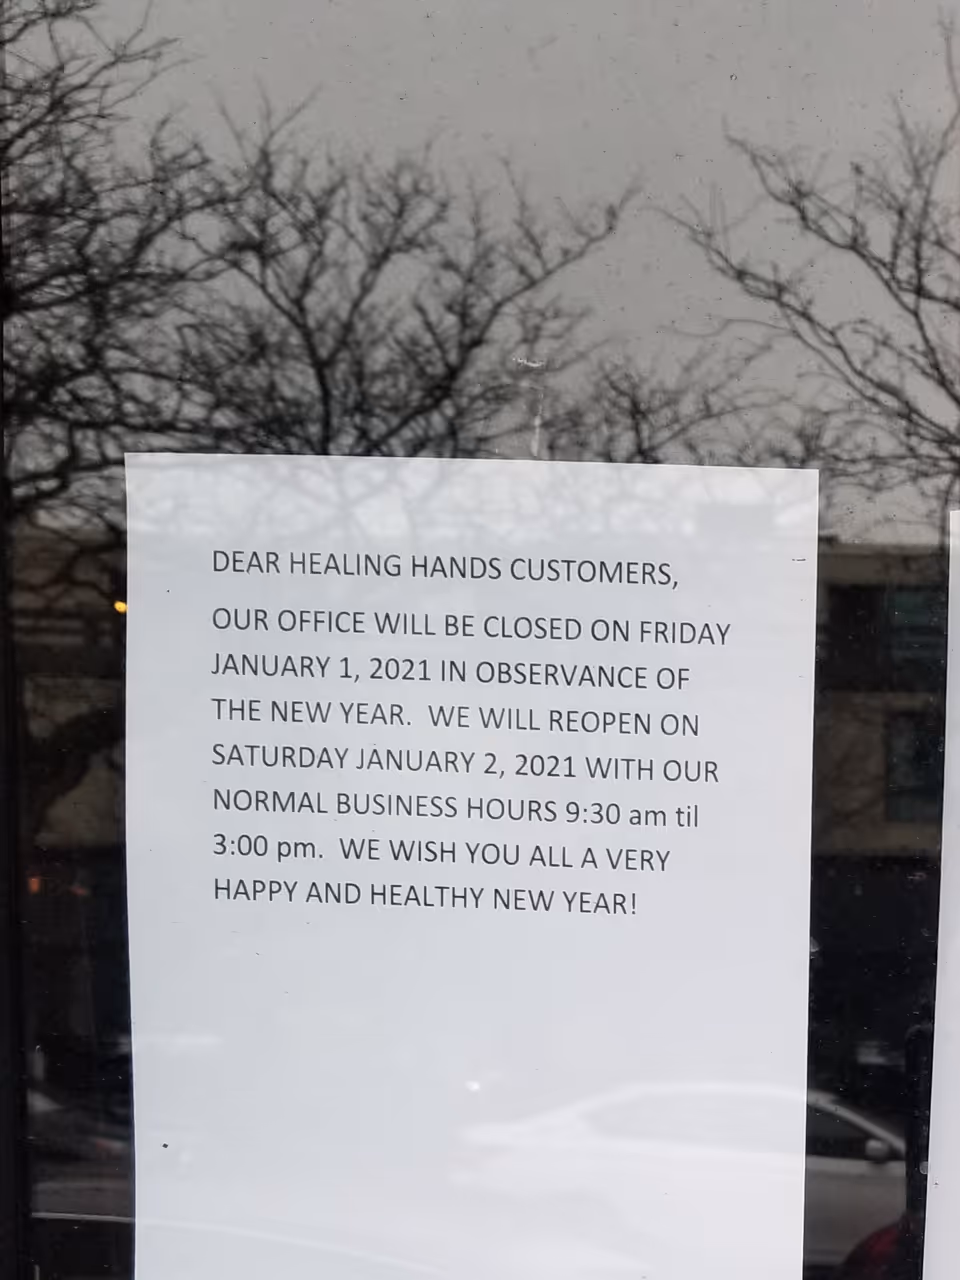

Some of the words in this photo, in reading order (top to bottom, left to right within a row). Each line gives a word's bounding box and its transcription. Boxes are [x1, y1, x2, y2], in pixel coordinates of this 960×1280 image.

[213, 550, 281, 574] DEAR
[290, 552, 401, 577] HEALING
[411, 555, 502, 580] HANDS
[510, 558, 678, 590] CUSTOMERS,
[212, 607, 269, 631] OUR
[277, 609, 365, 634] OFFICE
[374, 611, 436, 636] WILL
[445, 614, 475, 637] BE
[483, 615, 582, 640] CLOSED
[590, 619, 629, 642] ON
[640, 620, 731, 645] FRIDAY
[211, 652, 331, 678] JANUARY
[339, 656, 360, 683] 1,
[369, 657, 431, 681] 2021
[441, 659, 466, 682] IN
[476, 661, 648, 689] OBSERVANCE
[656, 667, 690, 690] OF
[211, 698, 261, 722] THE
[271, 700, 332, 723] NEW
[339, 702, 413, 726] YEAR.
[427, 705, 470, 728] WE
[478, 706, 541, 731] WILL
[549, 709, 651, 735] REOPEN
[660, 713, 699, 737] ON
[212, 743, 349, 769] SATURDAY
[355, 748, 476, 774] JANUARY
[483, 752, 505, 779] 2,
[515, 753, 577, 778] 2021
[585, 756, 653, 781] WITH
[663, 759, 719, 783] OUR
[214, 788, 328, 814] NORMAL
[337, 792, 458, 818] BUSINESS
[467, 797, 557, 822] HOURS
[565, 801, 621, 825] 9:30
[629, 809, 667, 827] am
[675, 804, 698, 828] til
[213, 833, 268, 857] 3:00
[277, 841, 323, 863] pm.
[339, 837, 380, 861] WE
[388, 839, 456, 863] WISH
[465, 842, 520, 866] YOU
[529, 845, 573, 868] ALL
[580, 847, 598, 869] A
[605, 848, 671, 872] VERY
[214, 878, 298, 902] HAPPY
[305, 881, 361, 904] AND
[371, 883, 484, 909] HEALTHY
[494, 888, 555, 912] NEW
[562, 891, 636, 915] YEAR!
